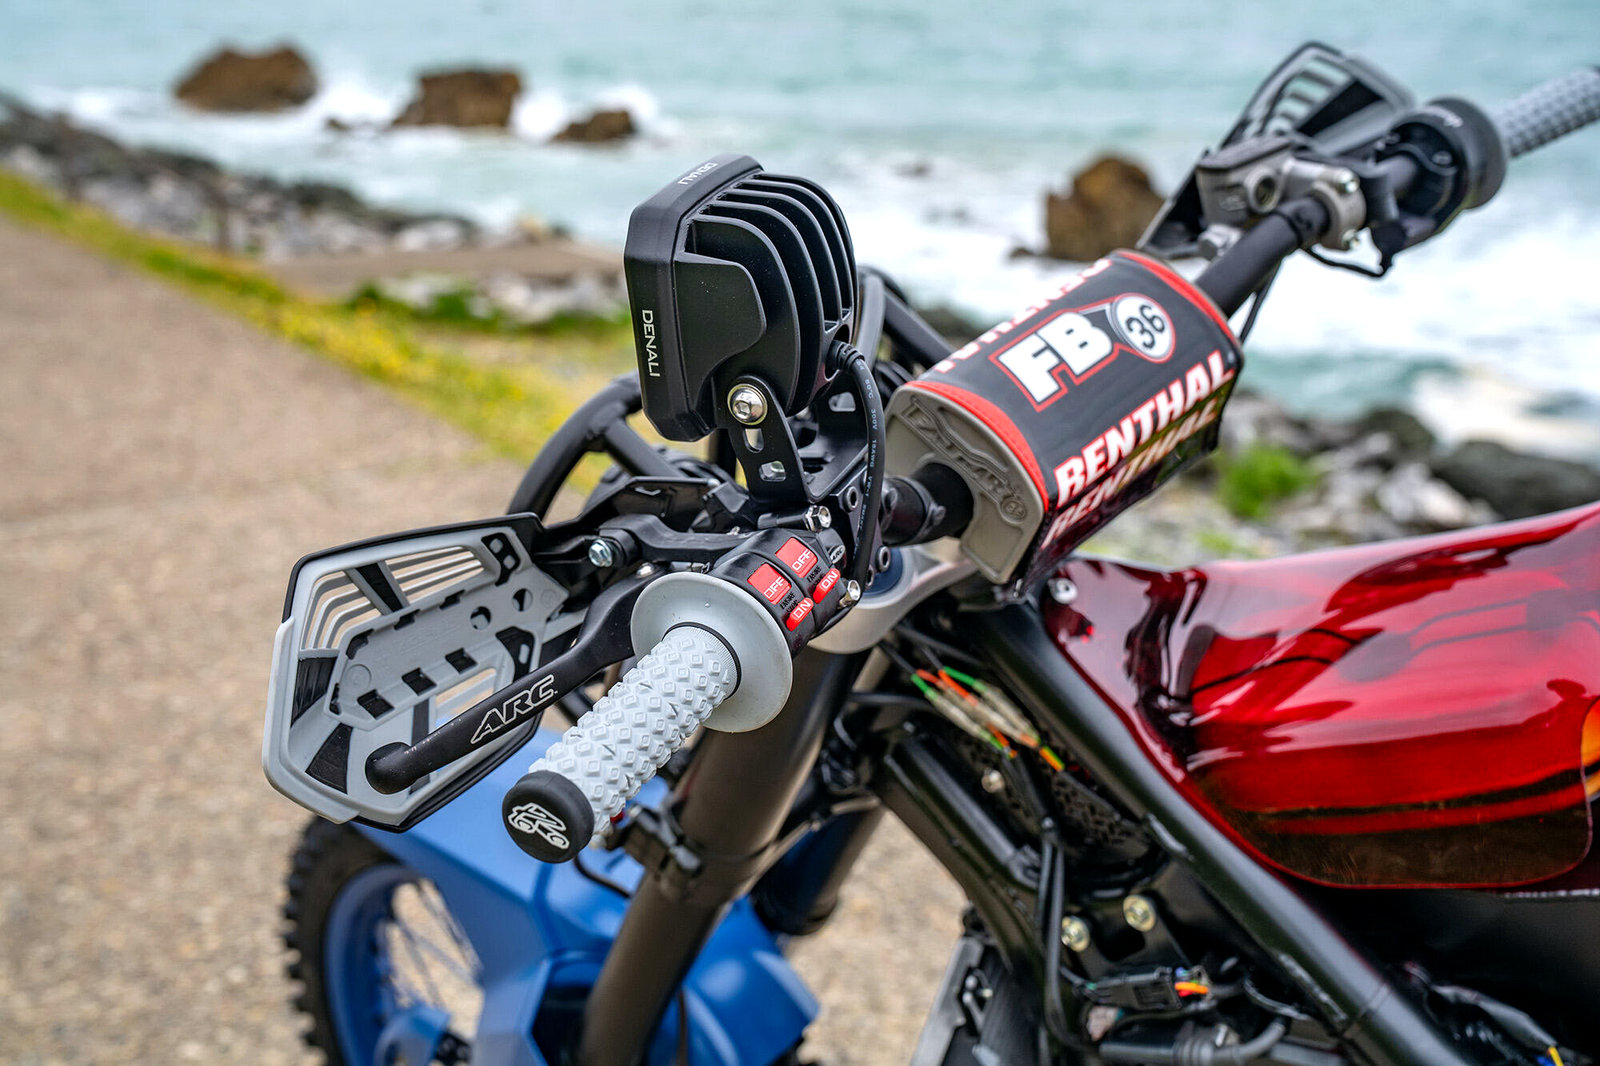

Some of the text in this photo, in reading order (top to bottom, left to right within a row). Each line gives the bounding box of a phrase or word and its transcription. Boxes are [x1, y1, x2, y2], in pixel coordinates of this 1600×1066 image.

[642, 309, 661, 377] DENALI
[994, 309, 1115, 406] FB
[1125, 303, 1166, 350] 36
[870, 408, 878, 430] 300V
[1053, 349, 1235, 509] RENTHAL
[791, 548, 812, 571] OFF
[763, 576, 785, 599] OFF
[820, 570, 838, 589] ON
[793, 599, 812, 618] ON
[470, 674, 555, 744] ARC
